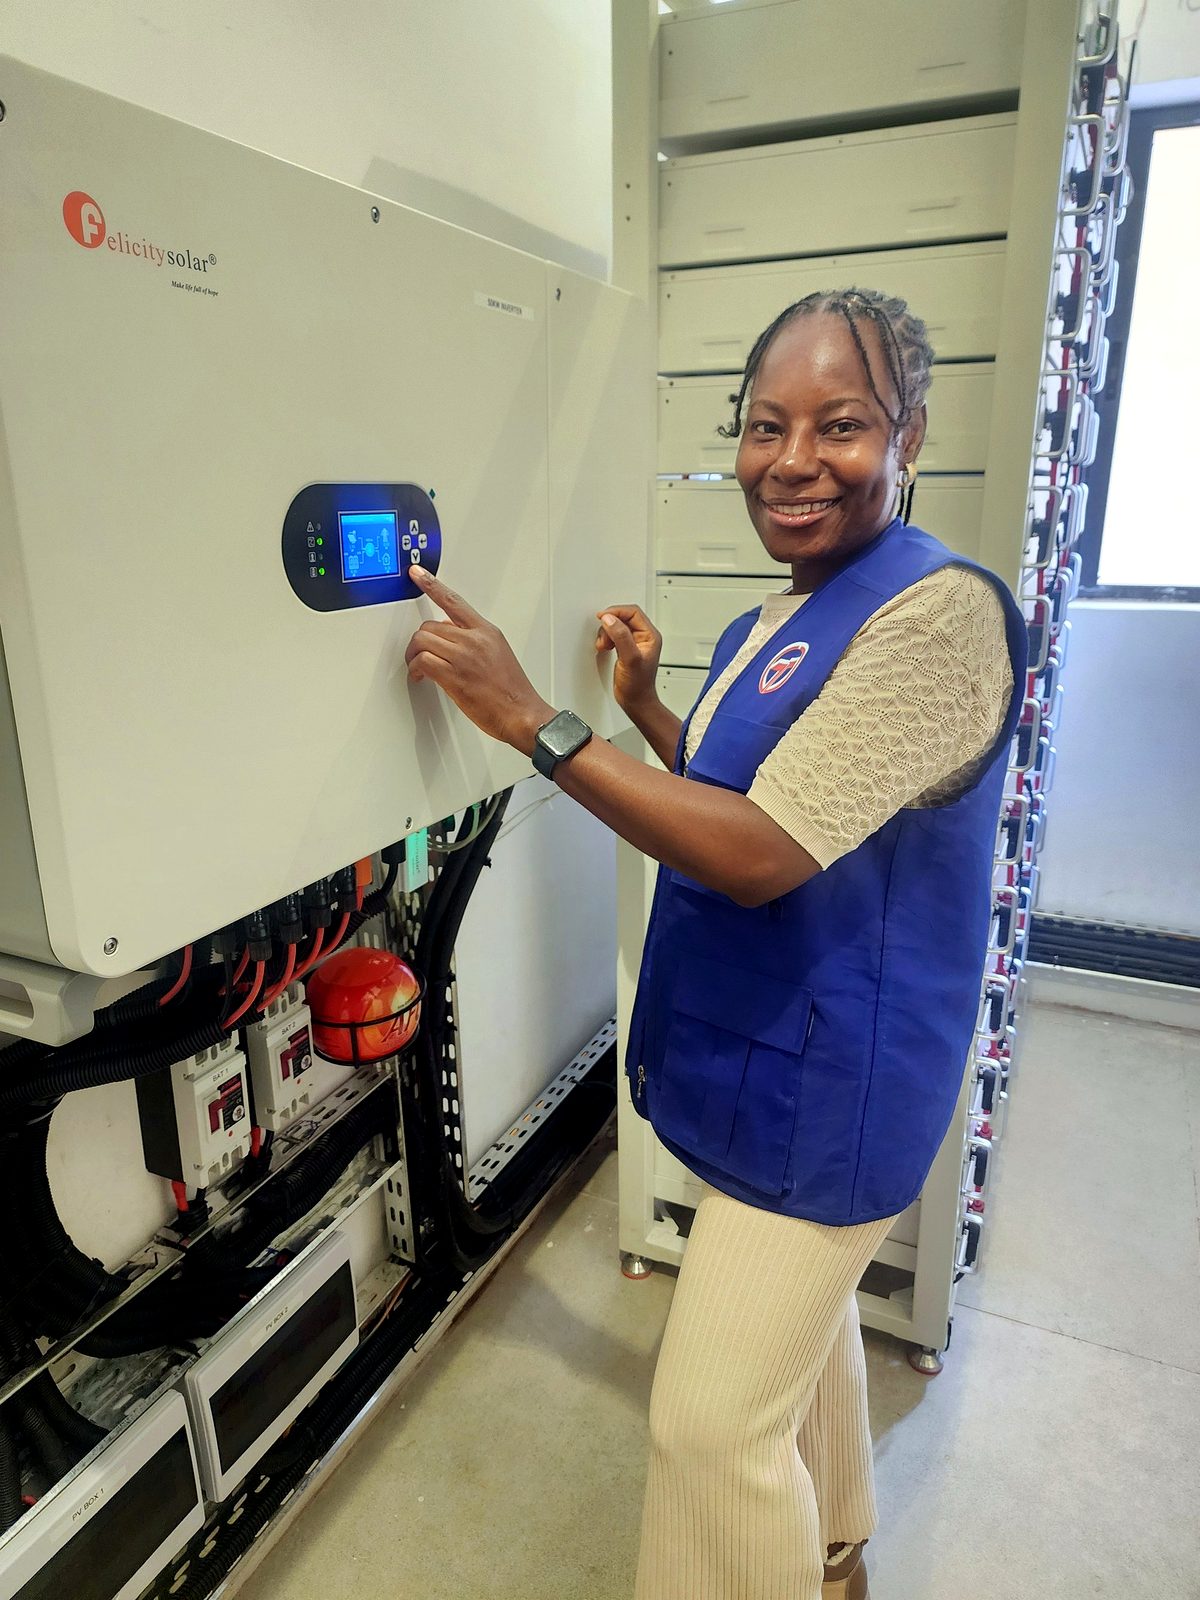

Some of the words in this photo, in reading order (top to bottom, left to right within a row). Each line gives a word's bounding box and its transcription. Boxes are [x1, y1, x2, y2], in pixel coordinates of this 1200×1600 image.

[171, 280, 185, 290] Make
[185, 283, 193, 292] life
[193, 285, 202, 293] full
[208, 288, 219, 297] hope
[281, 1023, 292, 1035] BAT
[212, 1070, 224, 1082] BAT
[265, 1321, 273, 1331] PV
[273, 1311, 284, 1324] BOX
[72, 1508, 82, 1521] PV
[83, 1493, 99, 1511] BOX
